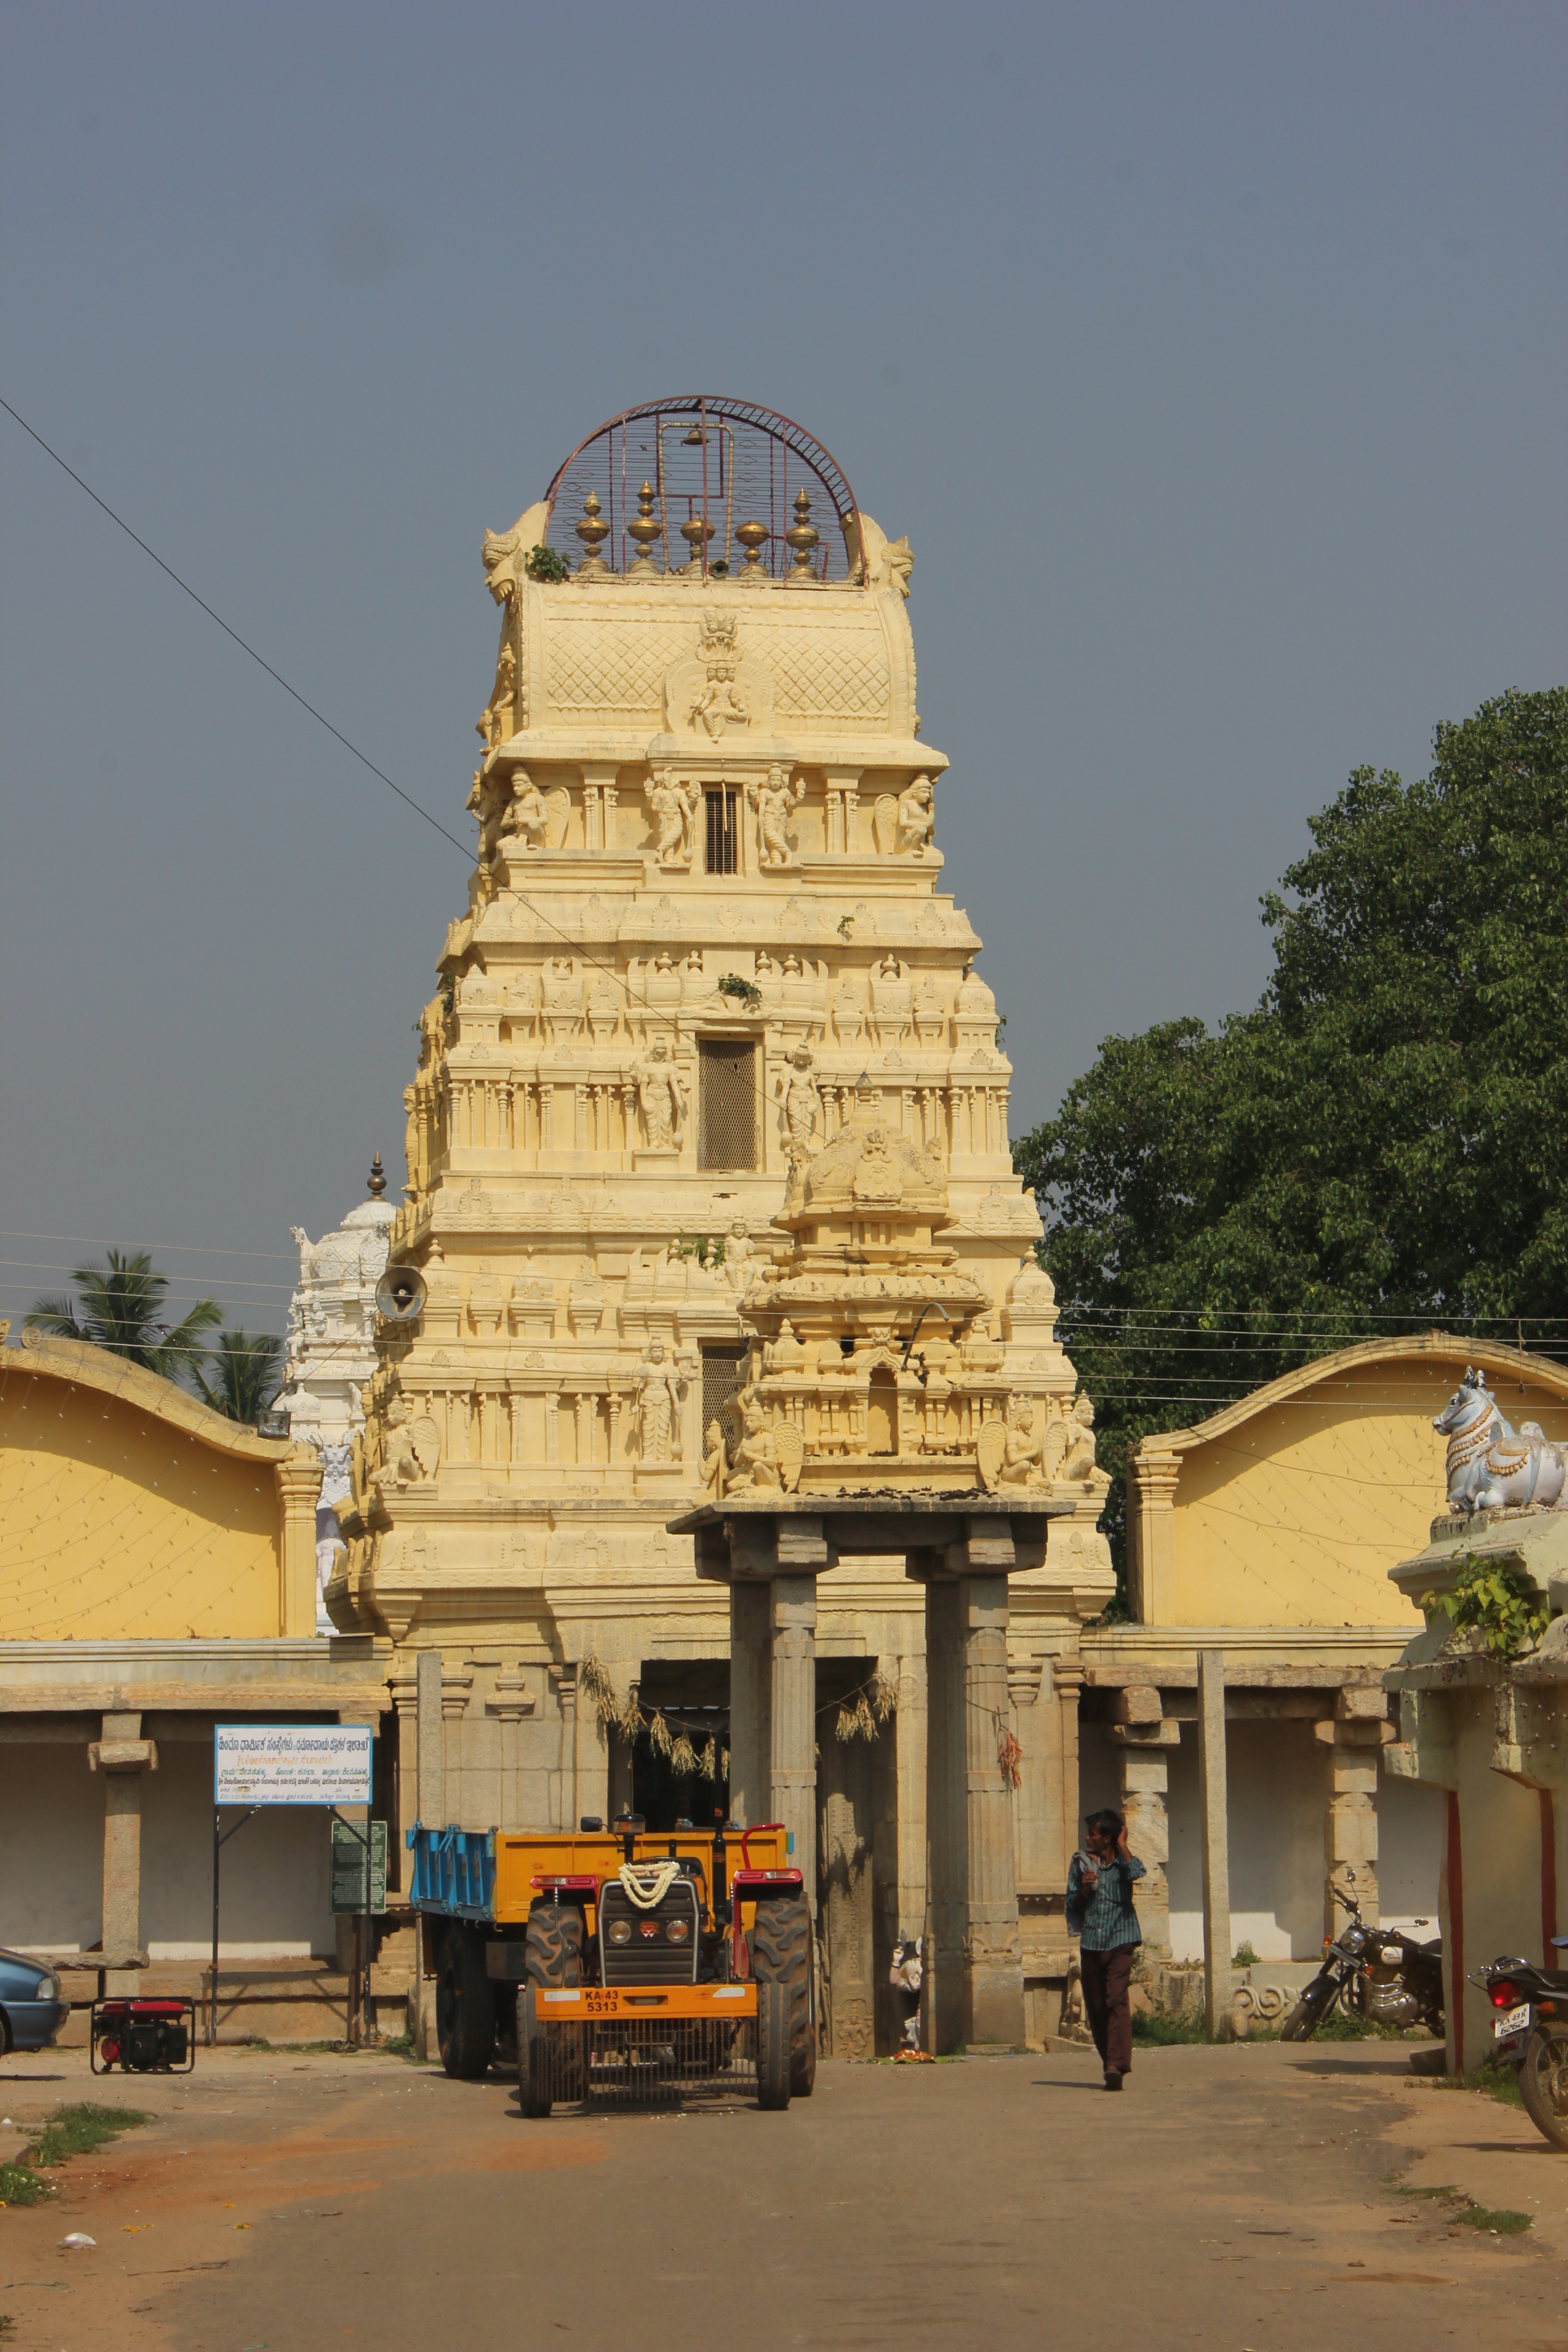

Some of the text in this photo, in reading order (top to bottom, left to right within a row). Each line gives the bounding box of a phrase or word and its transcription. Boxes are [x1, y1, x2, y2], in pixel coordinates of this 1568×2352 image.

[605, 1990, 618, 1999] 43
[587, 2001, 617, 2012] 5313
[1499, 2017, 1510, 2027] KA
[1500, 2019, 1525, 2034] 6262
